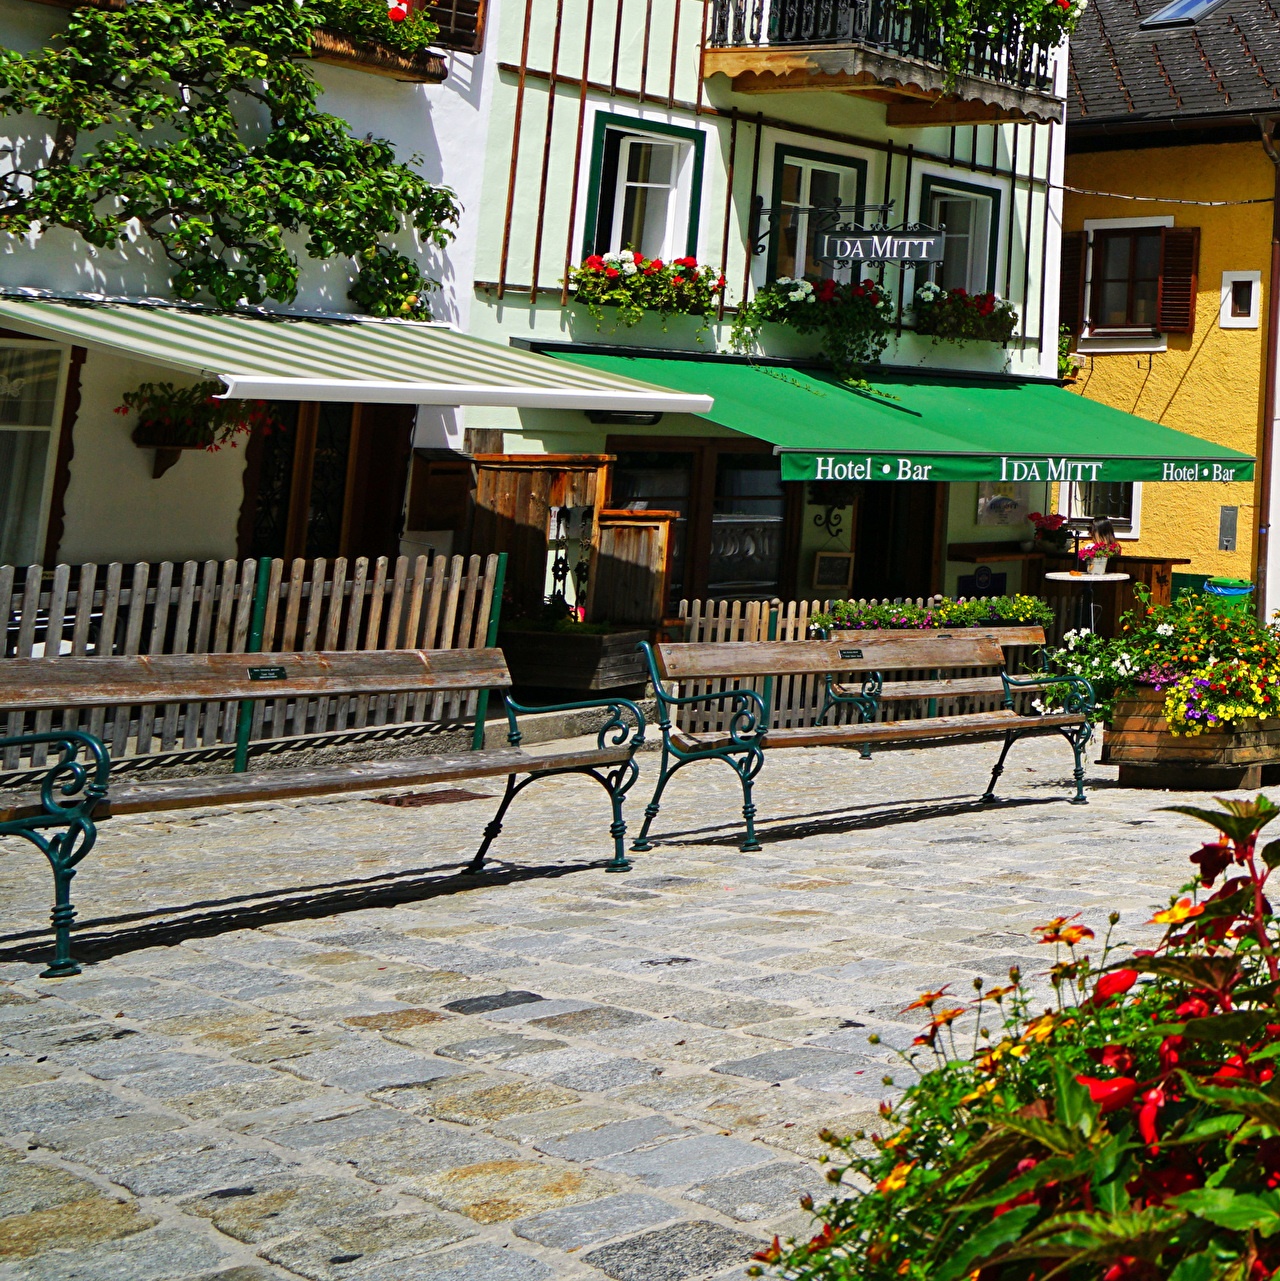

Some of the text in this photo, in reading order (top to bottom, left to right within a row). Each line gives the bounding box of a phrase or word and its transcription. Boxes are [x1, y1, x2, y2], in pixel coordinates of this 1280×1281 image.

[870, 235, 935, 259] MITT
[815, 457, 932, 481] Hotel Bar
[1046, 458, 1103, 481] MITT
[1162, 462, 1236, 481] Hotel Bar
